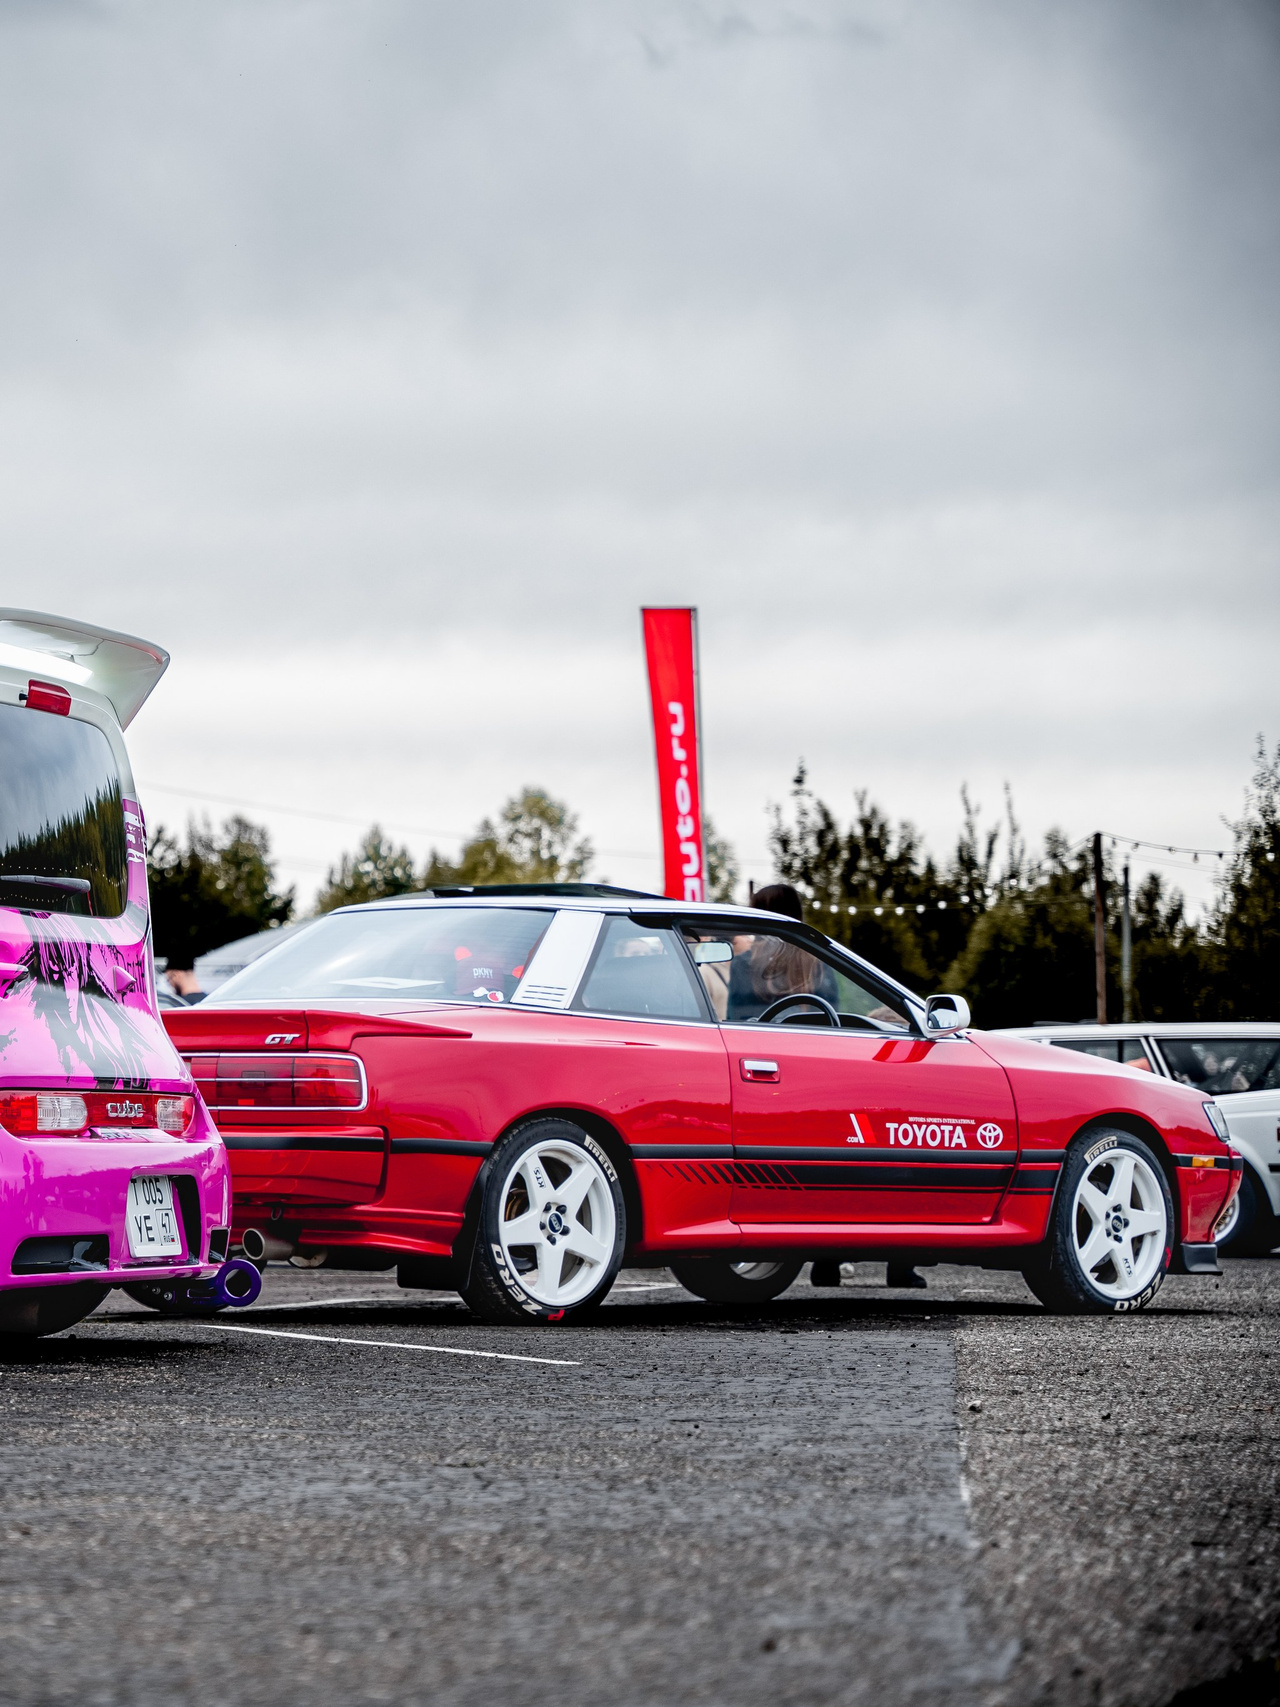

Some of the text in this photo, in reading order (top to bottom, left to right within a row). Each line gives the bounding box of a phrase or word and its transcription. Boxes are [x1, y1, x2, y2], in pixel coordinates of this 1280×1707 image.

[473, 967, 493, 976] DKNY
[265, 1034, 301, 1044] GT
[106, 1100, 144, 1117] cube
[886, 1123, 967, 1148] TOYOTA
[584, 1134, 618, 1183] PIRELLI
[1083, 1135, 1118, 1165] PIRELLI
[142, 1178, 163, 1205] 005
[491, 1243, 542, 1315] ZERO
